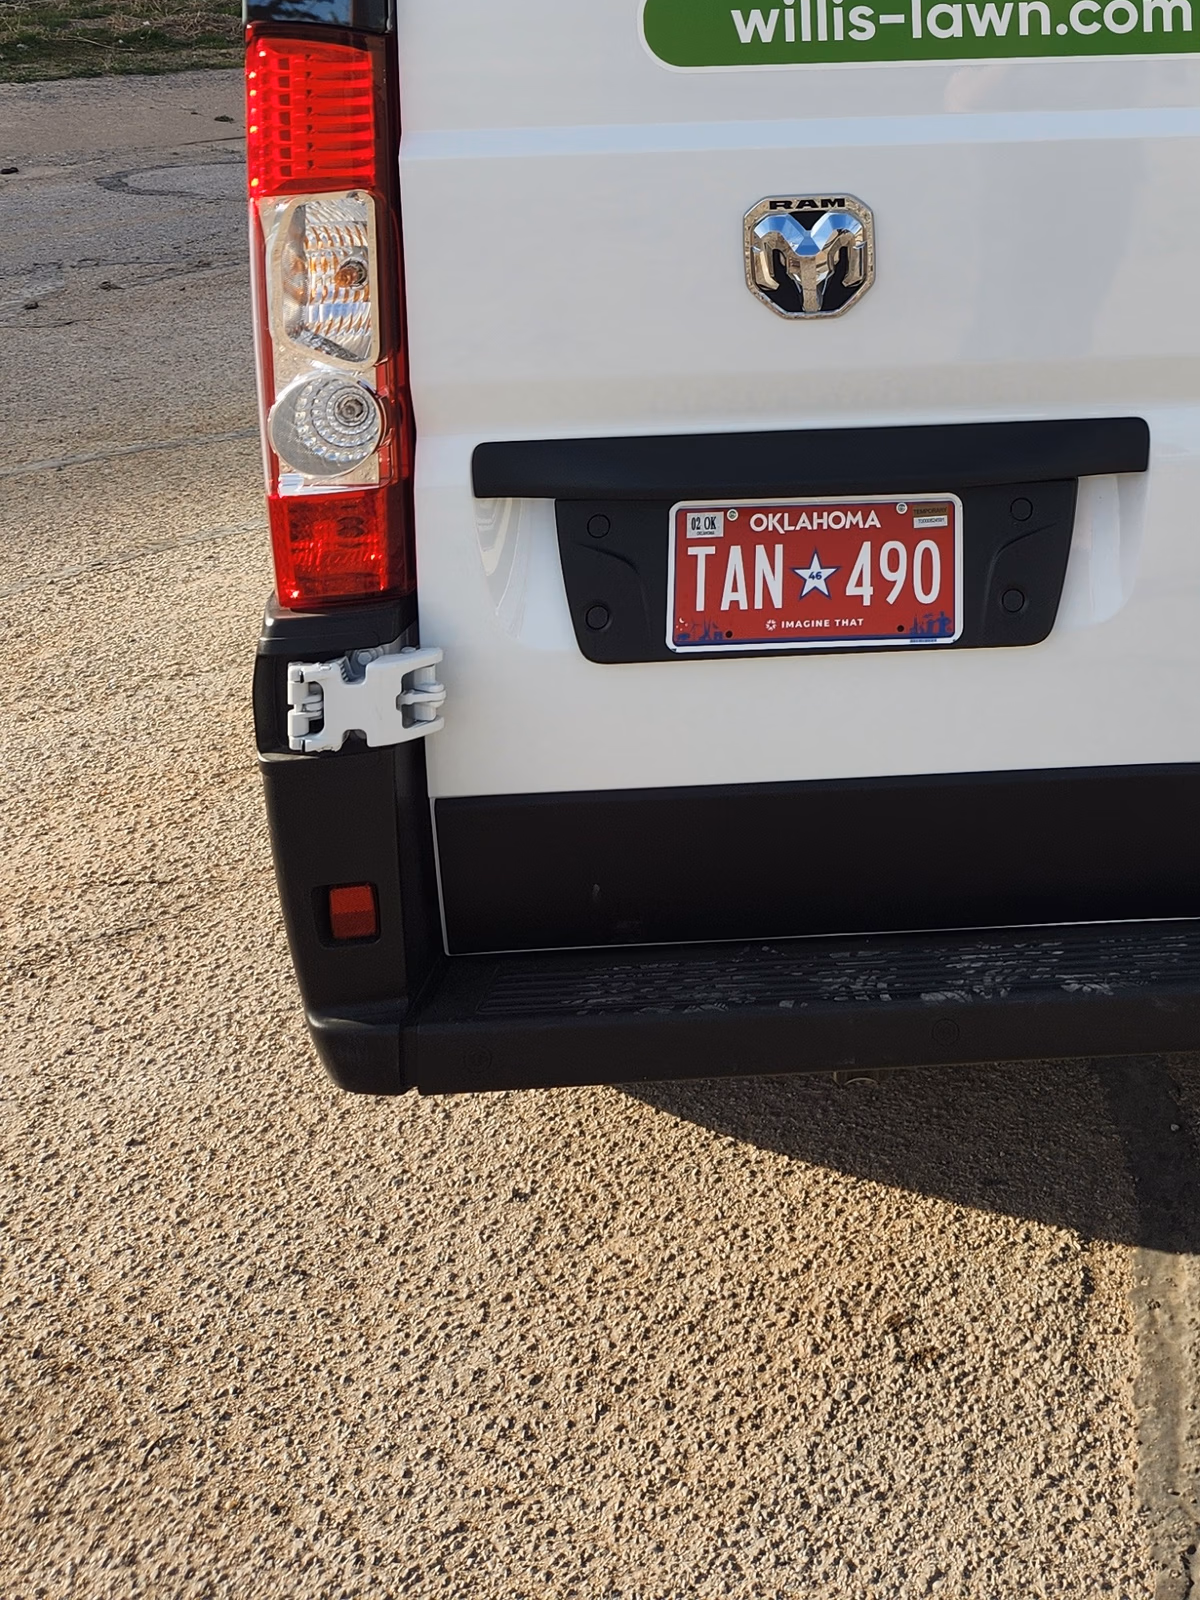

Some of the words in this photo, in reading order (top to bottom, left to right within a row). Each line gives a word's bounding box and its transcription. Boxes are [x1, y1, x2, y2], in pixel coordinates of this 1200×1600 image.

[769, 198, 846, 210] RAM
[691, 516, 702, 531] 02
[704, 515, 717, 531] OK
[750, 510, 881, 533] OKLAHOMA
[687, 543, 783, 611] TAN
[845, 539, 941, 606] 490
[808, 571, 823, 580] 46
[781, 619, 830, 629] IMAGINE
[834, 618, 864, 627] THAT
